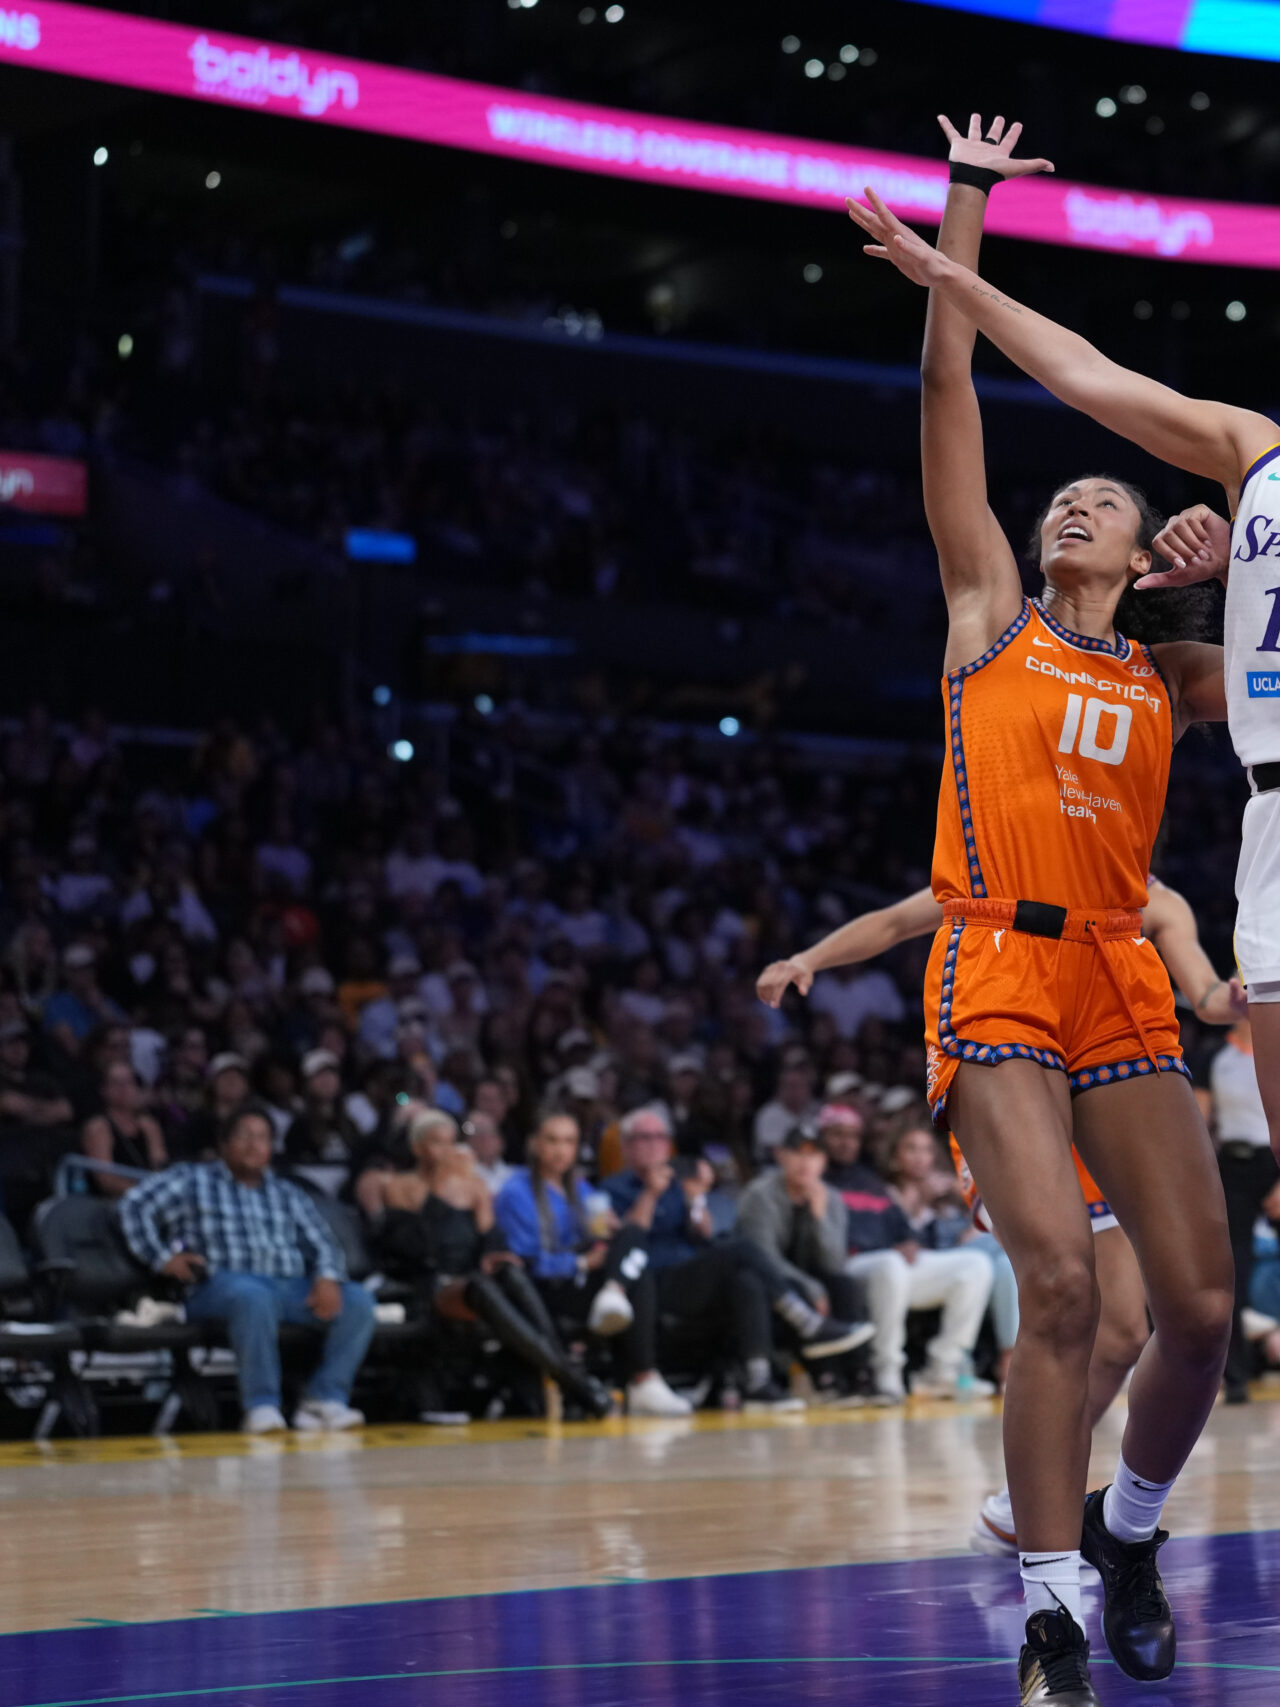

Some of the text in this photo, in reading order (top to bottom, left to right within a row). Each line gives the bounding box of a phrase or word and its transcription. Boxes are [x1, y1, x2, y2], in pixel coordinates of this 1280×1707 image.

[188, 34, 358, 116] boldyn
[486, 103, 636, 163] WIRELESS
[640, 130, 790, 188] COVERAGE
[1064, 186, 1214, 256] boldyn
[1057, 692, 1133, 766] 10
[1055, 764, 1079, 784] Yale
